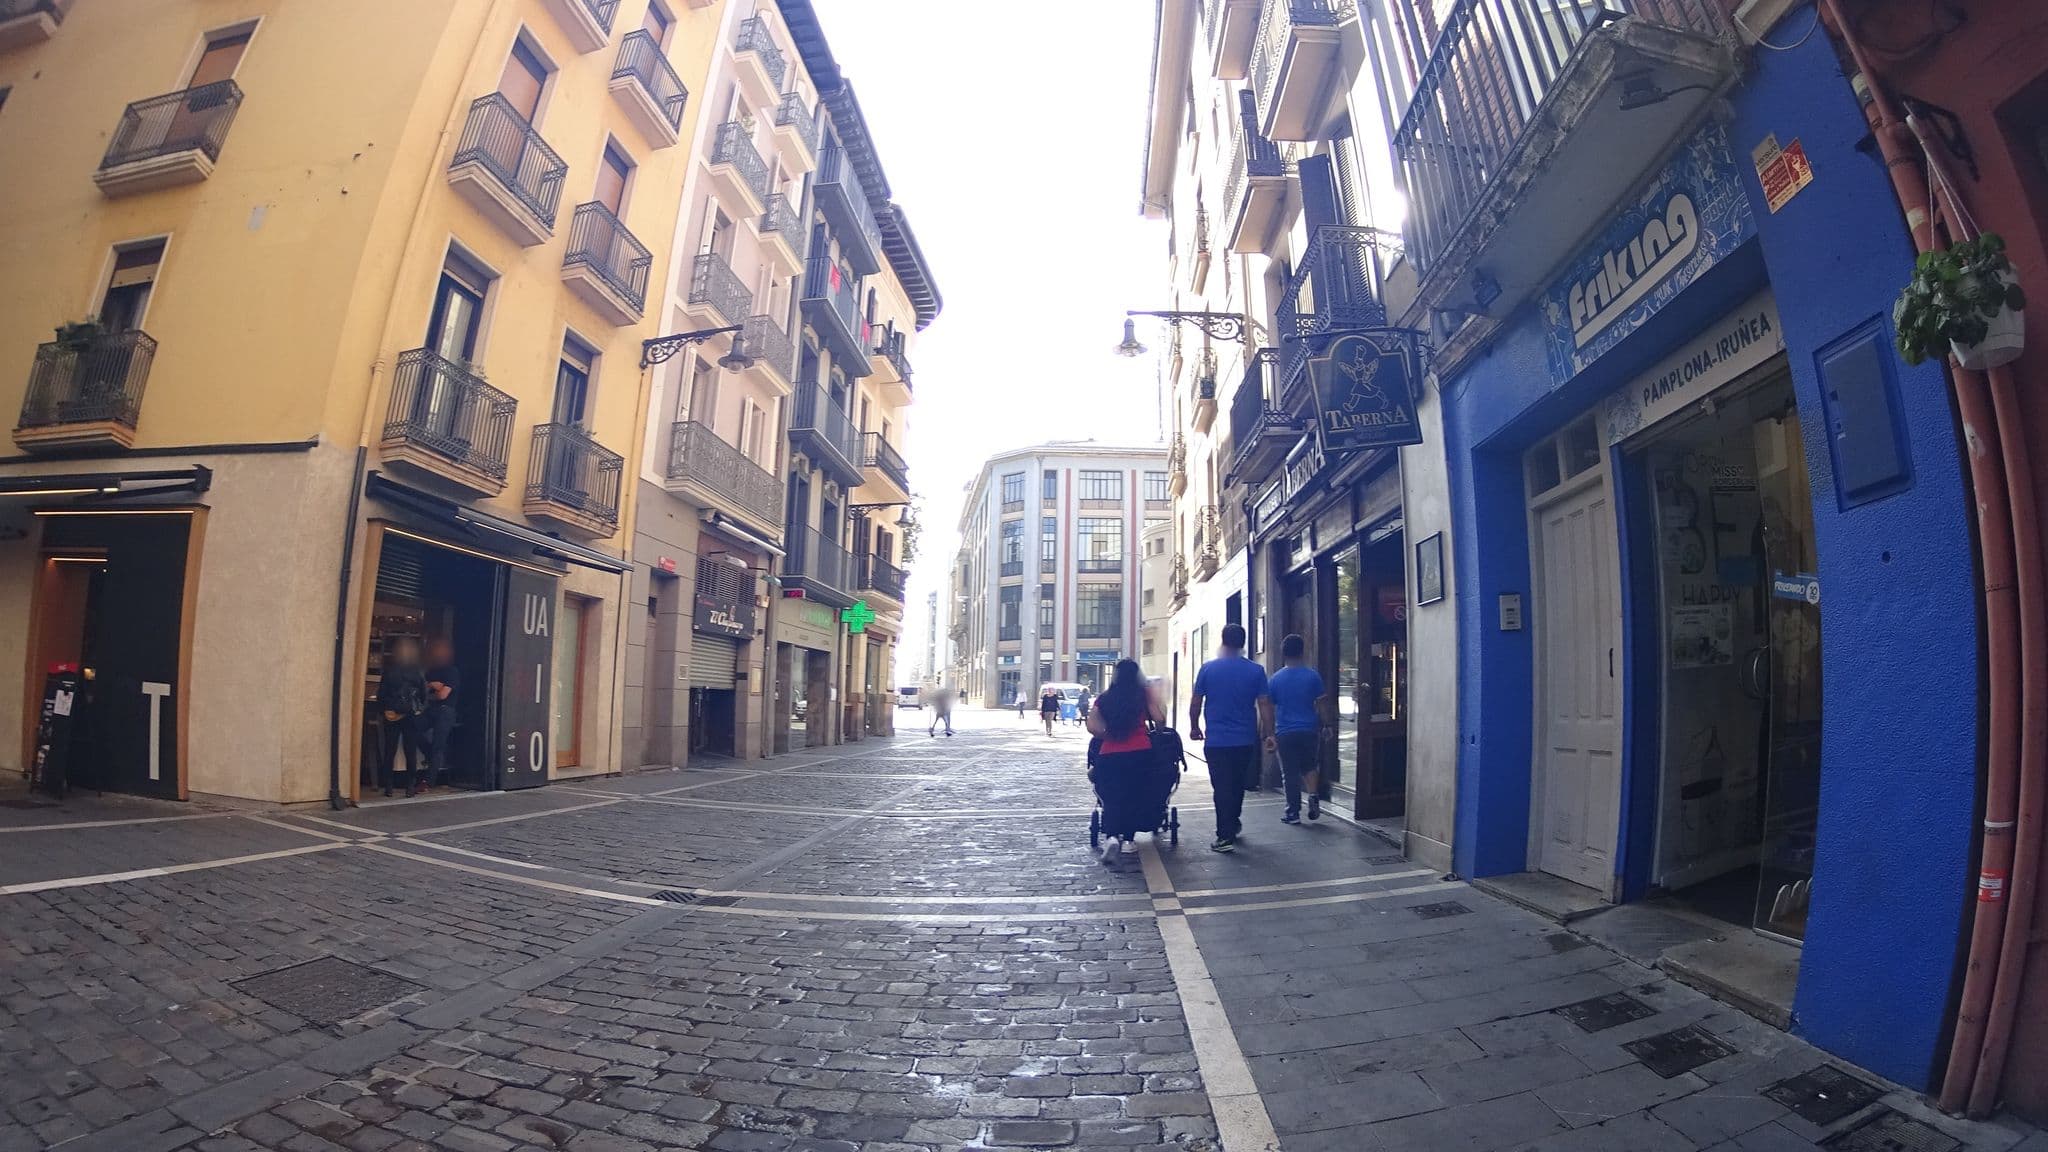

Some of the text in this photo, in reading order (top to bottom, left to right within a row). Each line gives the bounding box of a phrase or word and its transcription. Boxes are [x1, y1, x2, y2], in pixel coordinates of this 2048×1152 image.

[1569, 193, 1698, 349] friking
[1643, 311, 1772, 407] PAMPLONA-IRUÑEA
[142, 681, 171, 781] T
